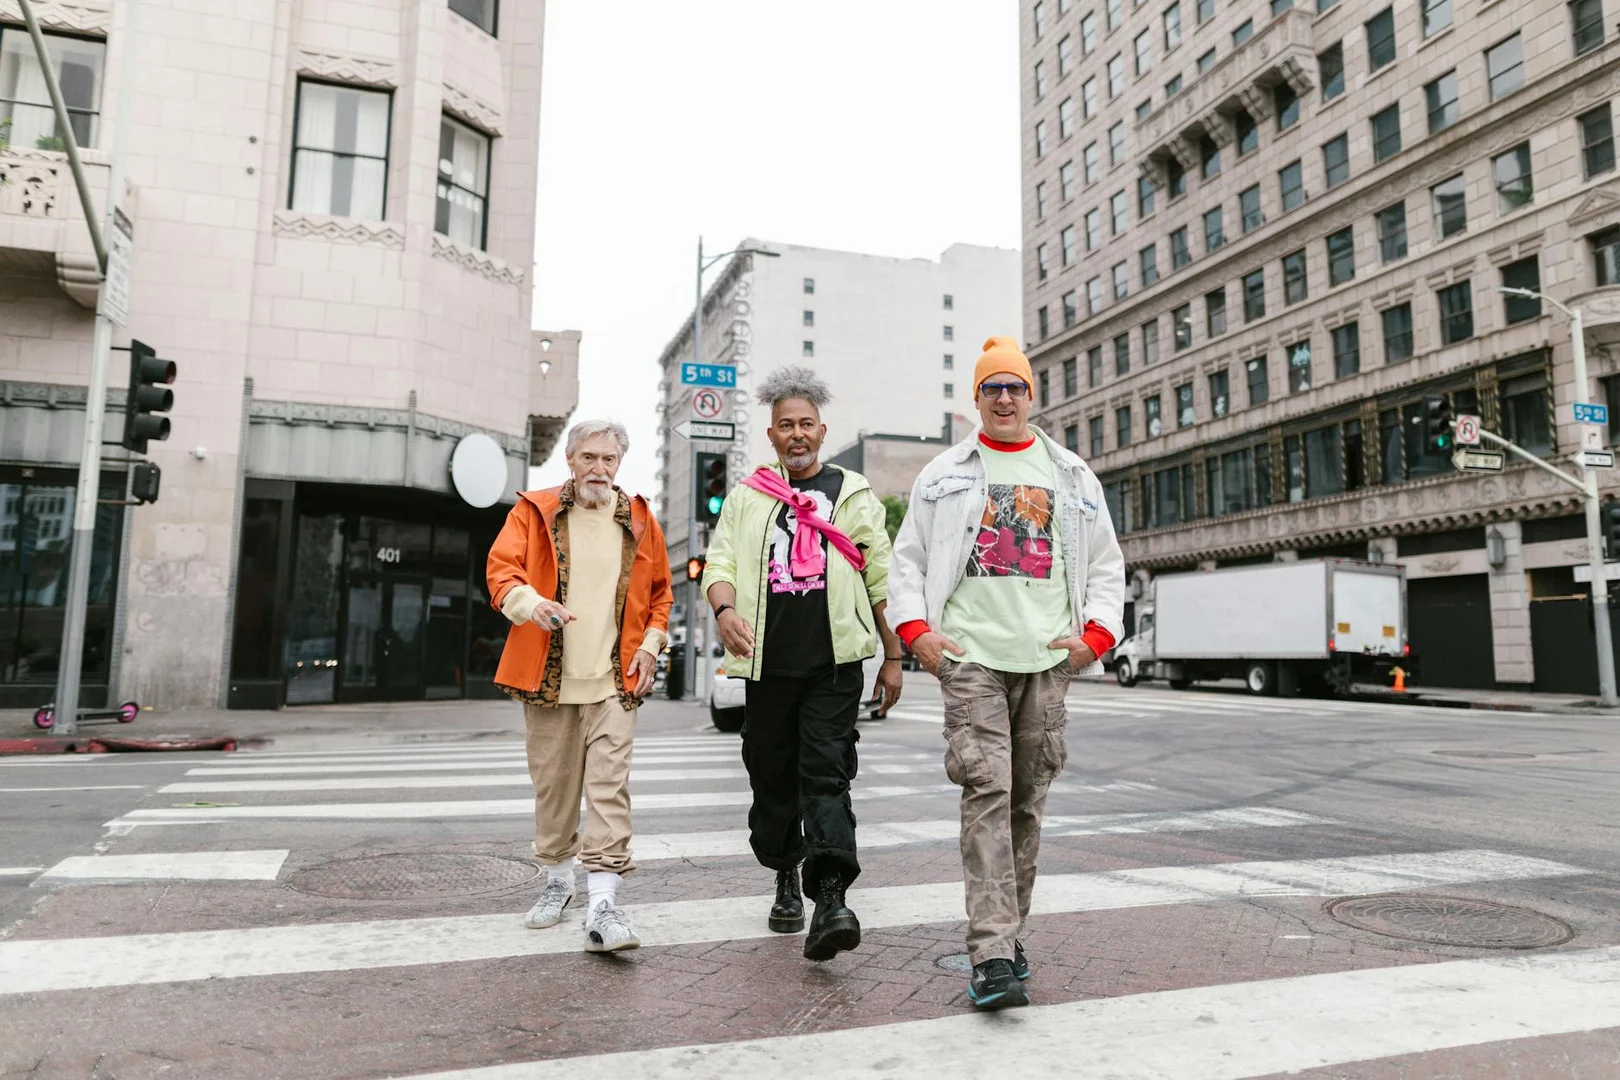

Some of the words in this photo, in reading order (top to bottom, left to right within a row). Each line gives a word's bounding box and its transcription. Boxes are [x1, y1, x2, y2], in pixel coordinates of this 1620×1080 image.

[686, 365, 712, 382] 5th
[717, 369, 733, 383] St
[1575, 405, 1592, 419] 5th
[1593, 408, 1605, 420] St
[690, 426, 709, 435] ONE
[711, 427, 729, 436] WAY
[377, 547, 400, 563] 401
